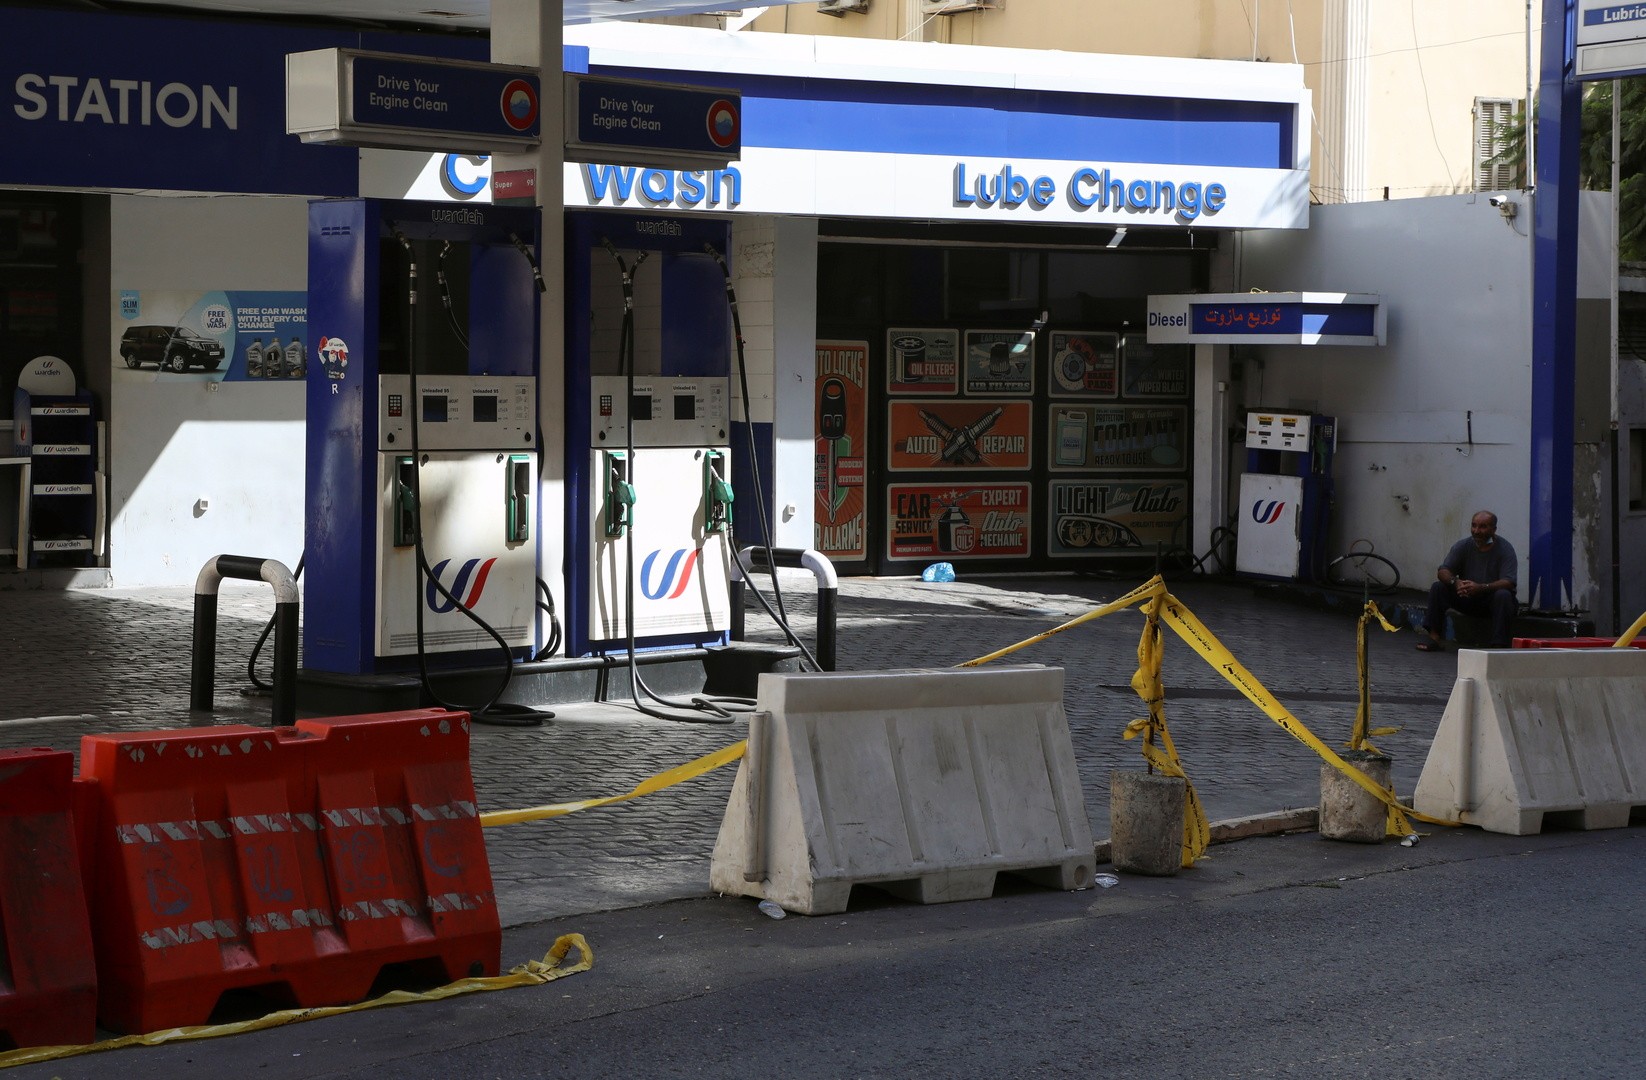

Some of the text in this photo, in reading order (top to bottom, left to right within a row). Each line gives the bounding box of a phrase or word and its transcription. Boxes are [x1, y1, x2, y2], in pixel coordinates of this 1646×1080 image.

[377, 74, 440, 94] Drive Your
[13, 73, 238, 130] STATION
[369, 93, 448, 113] Engine Clean
[599, 97, 654, 114] Drive Your
[593, 113, 662, 132] Engine Clean
[494, 181, 513, 189] Super
[957, 162, 1227, 220] Lube Change
[431, 208, 484, 225] wardieh
[636, 220, 682, 236] wardieh
[122, 300, 138, 309] SLIM
[237, 307, 307, 315] FREE CAR WASH
[207, 310, 226, 318] FREE
[1149, 312, 1187, 327] Diesel
[1205, 307, 1281, 329] توزيع مازوت
[237, 321, 275, 329] CHANGE
[833, 350, 863, 389] LOCKS
[911, 362, 955, 376] OIL FILTERS
[1157, 369, 1185, 380] WINTER
[331, 383, 339, 395] R
[1088, 380, 1113, 390] PADS
[1137, 381, 1185, 393] WIPER BLADE
[55, 445, 80, 453] wardieh
[905, 435, 1025, 454] AUTO REPAIR
[838, 460, 863, 469] MODERN
[1094, 451, 1147, 465] READY TO USE
[981, 489, 1022, 506] EXPERT
[1056, 486, 1182, 514] LIGHT for Auto
[896, 493, 931, 519] CAR
[895, 520, 933, 534] SERVICE
[981, 511, 1024, 532] Auto
[823, 512, 862, 550] ALARMS
[956, 534, 974, 550] OILS
[980, 532, 1023, 547] MECHANIC
